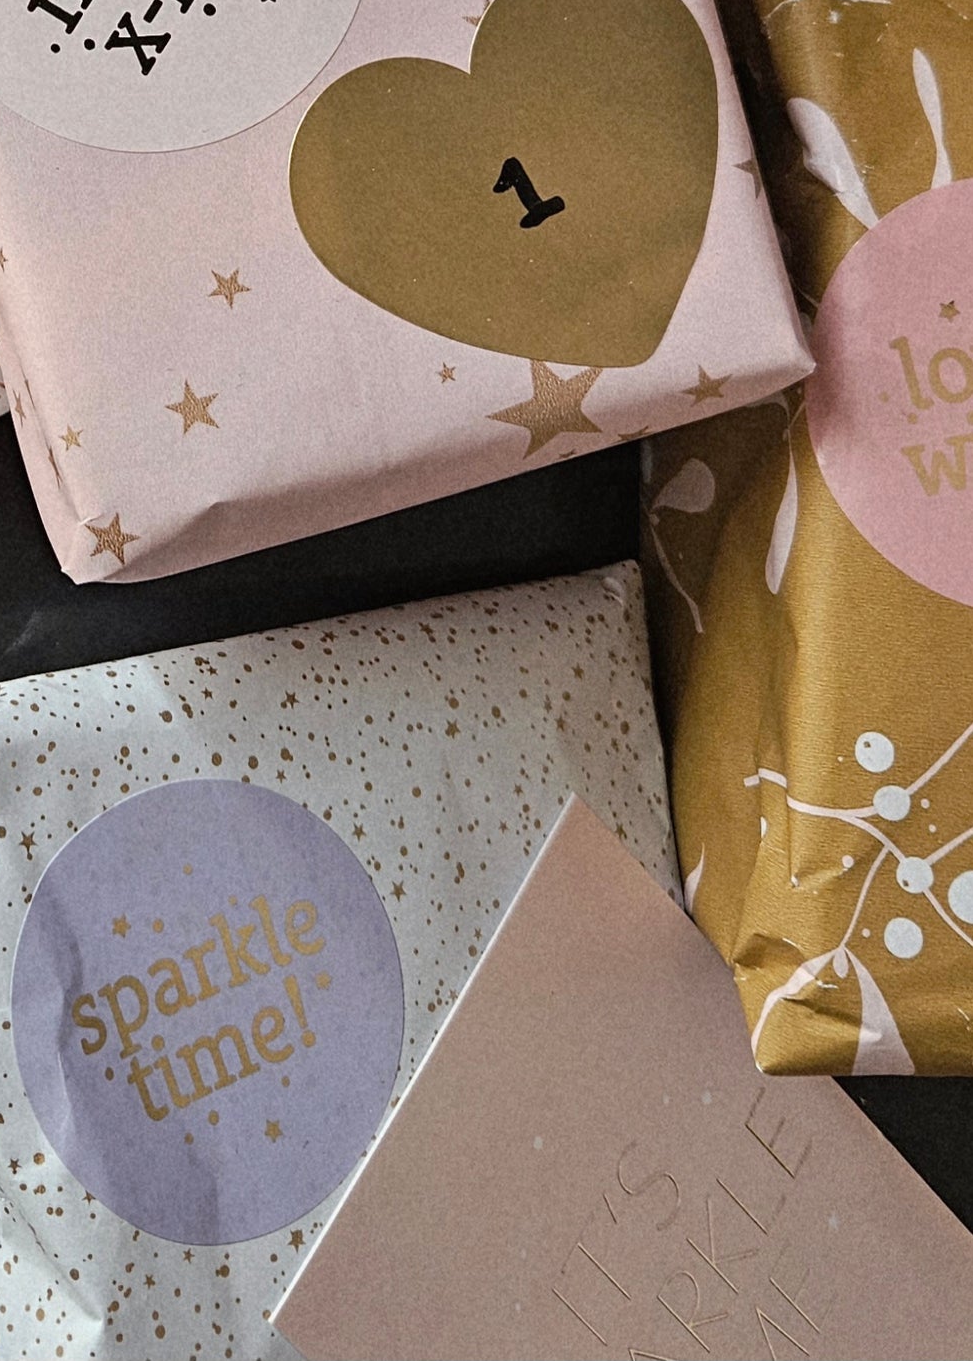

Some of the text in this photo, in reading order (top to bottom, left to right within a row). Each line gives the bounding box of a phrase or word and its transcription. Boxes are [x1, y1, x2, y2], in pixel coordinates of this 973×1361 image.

[493, 157, 566, 229] 1
[71, 895, 325, 1059] sparkle
[127, 975, 317, 1122] time!
